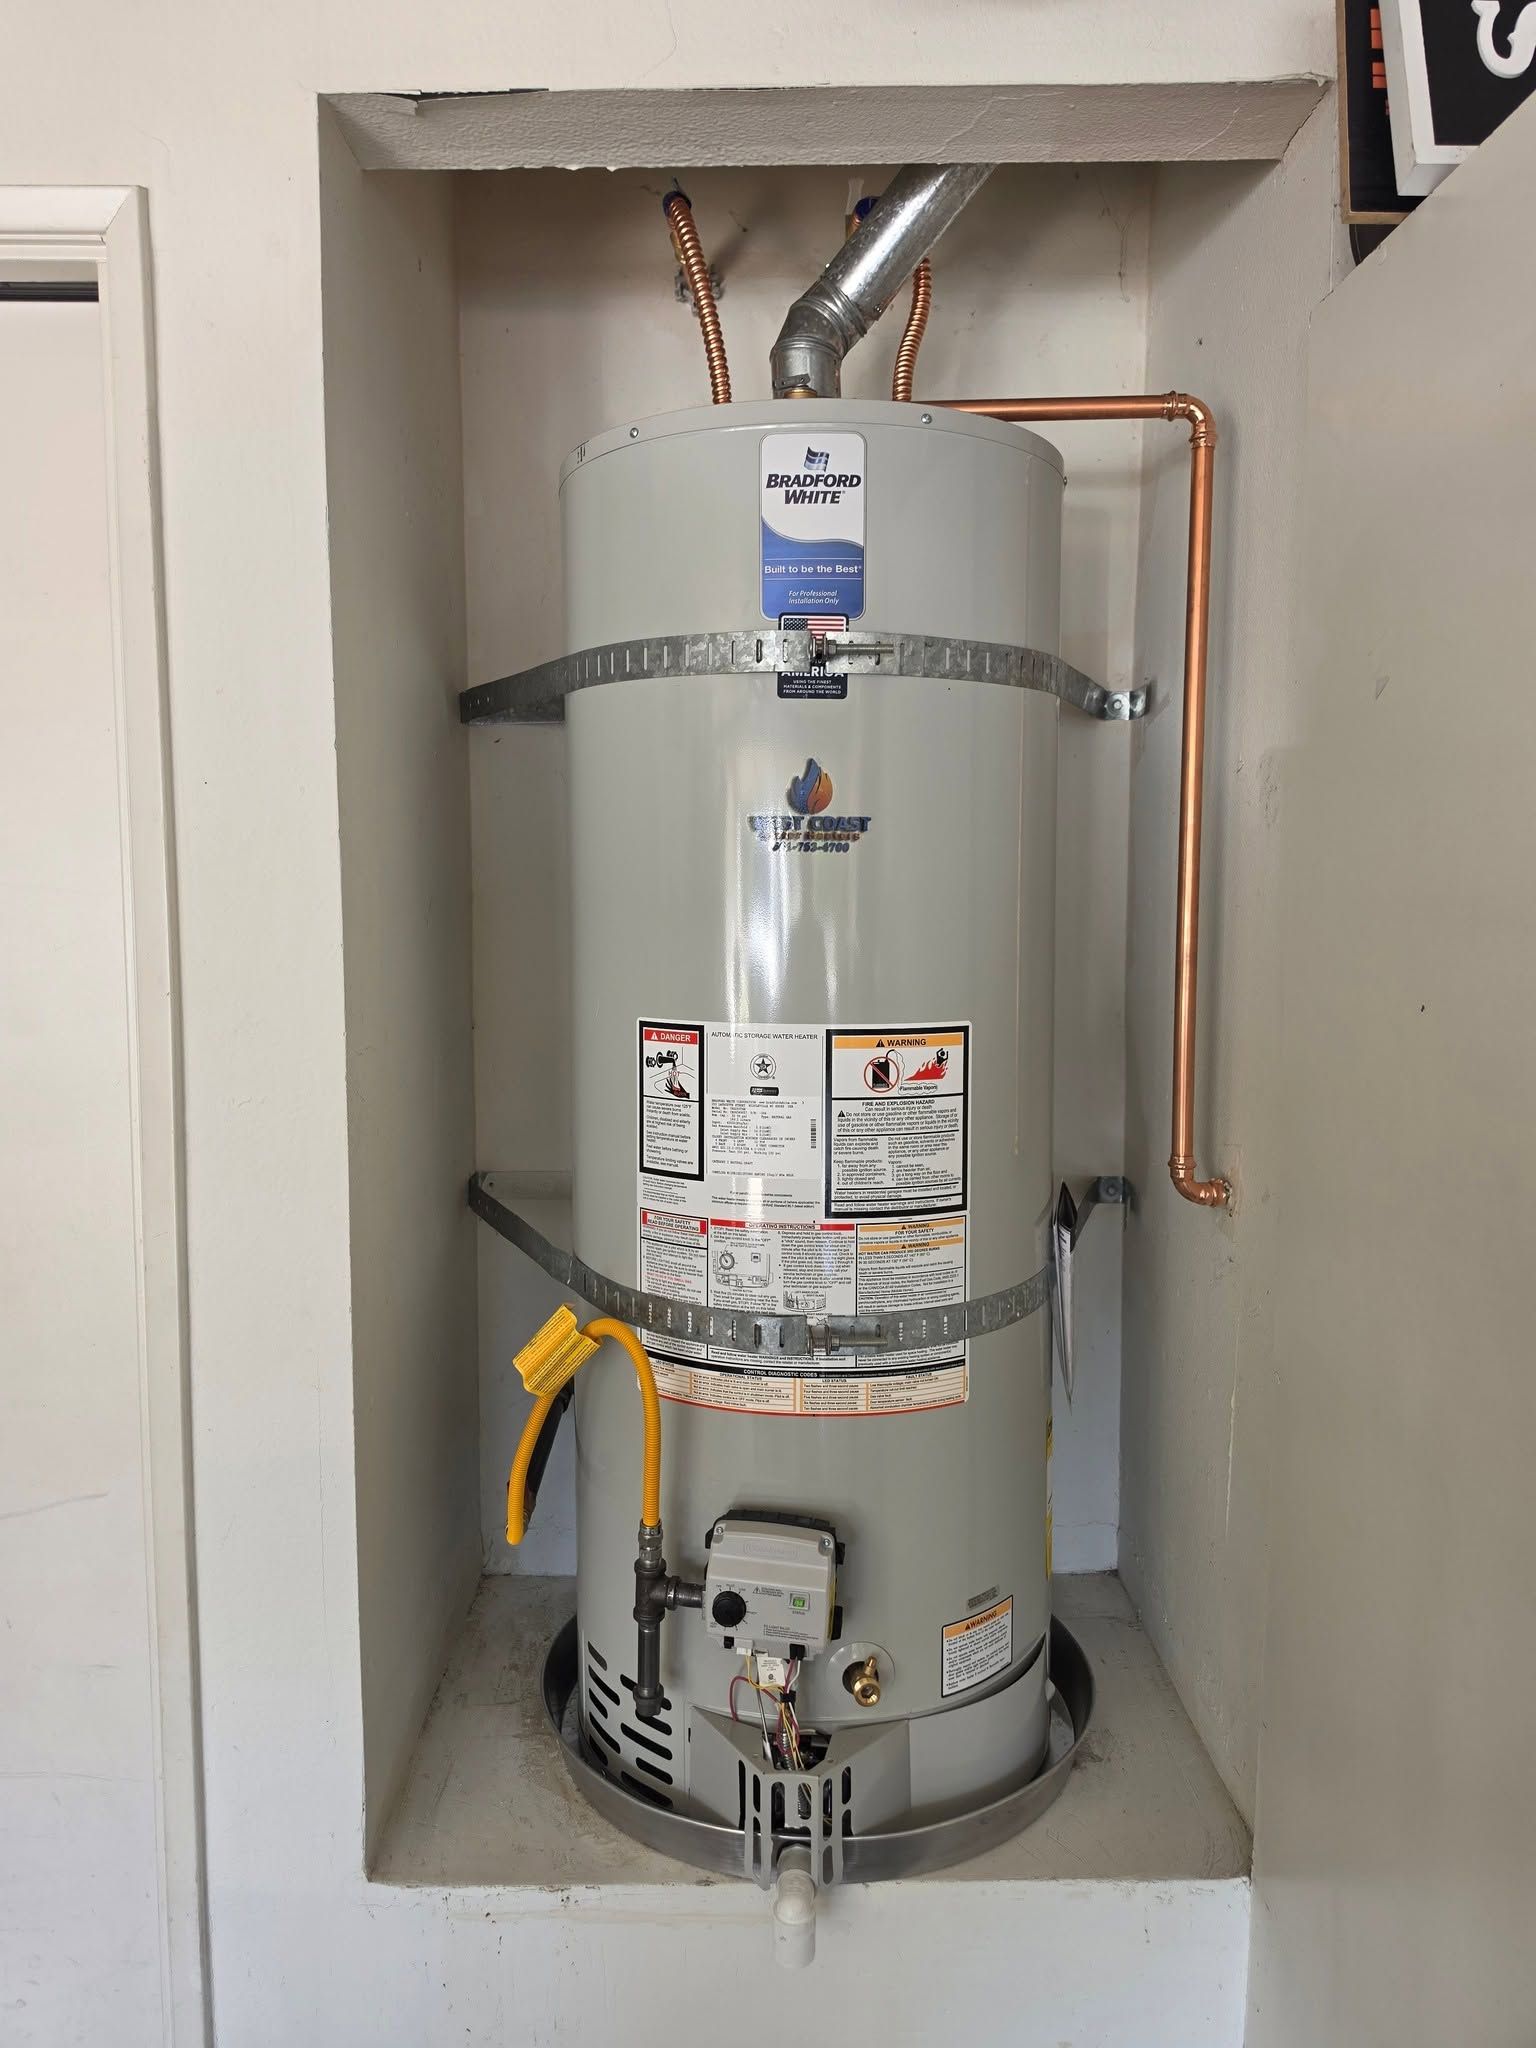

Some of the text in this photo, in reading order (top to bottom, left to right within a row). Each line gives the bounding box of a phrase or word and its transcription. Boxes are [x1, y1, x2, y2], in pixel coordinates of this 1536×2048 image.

[766, 473, 862, 488] BRADFORD
[784, 489, 842, 504] WHITE
[764, 565, 786, 574] Built
[801, 565, 814, 573] be
[817, 565, 832, 573] the
[836, 565, 858, 573] Best
[807, 816, 872, 832] COAST
[660, 1033, 691, 1042] DANGER
[887, 1038, 926, 1046] WARNING
[970, 1610, 997, 1629] WARNING
